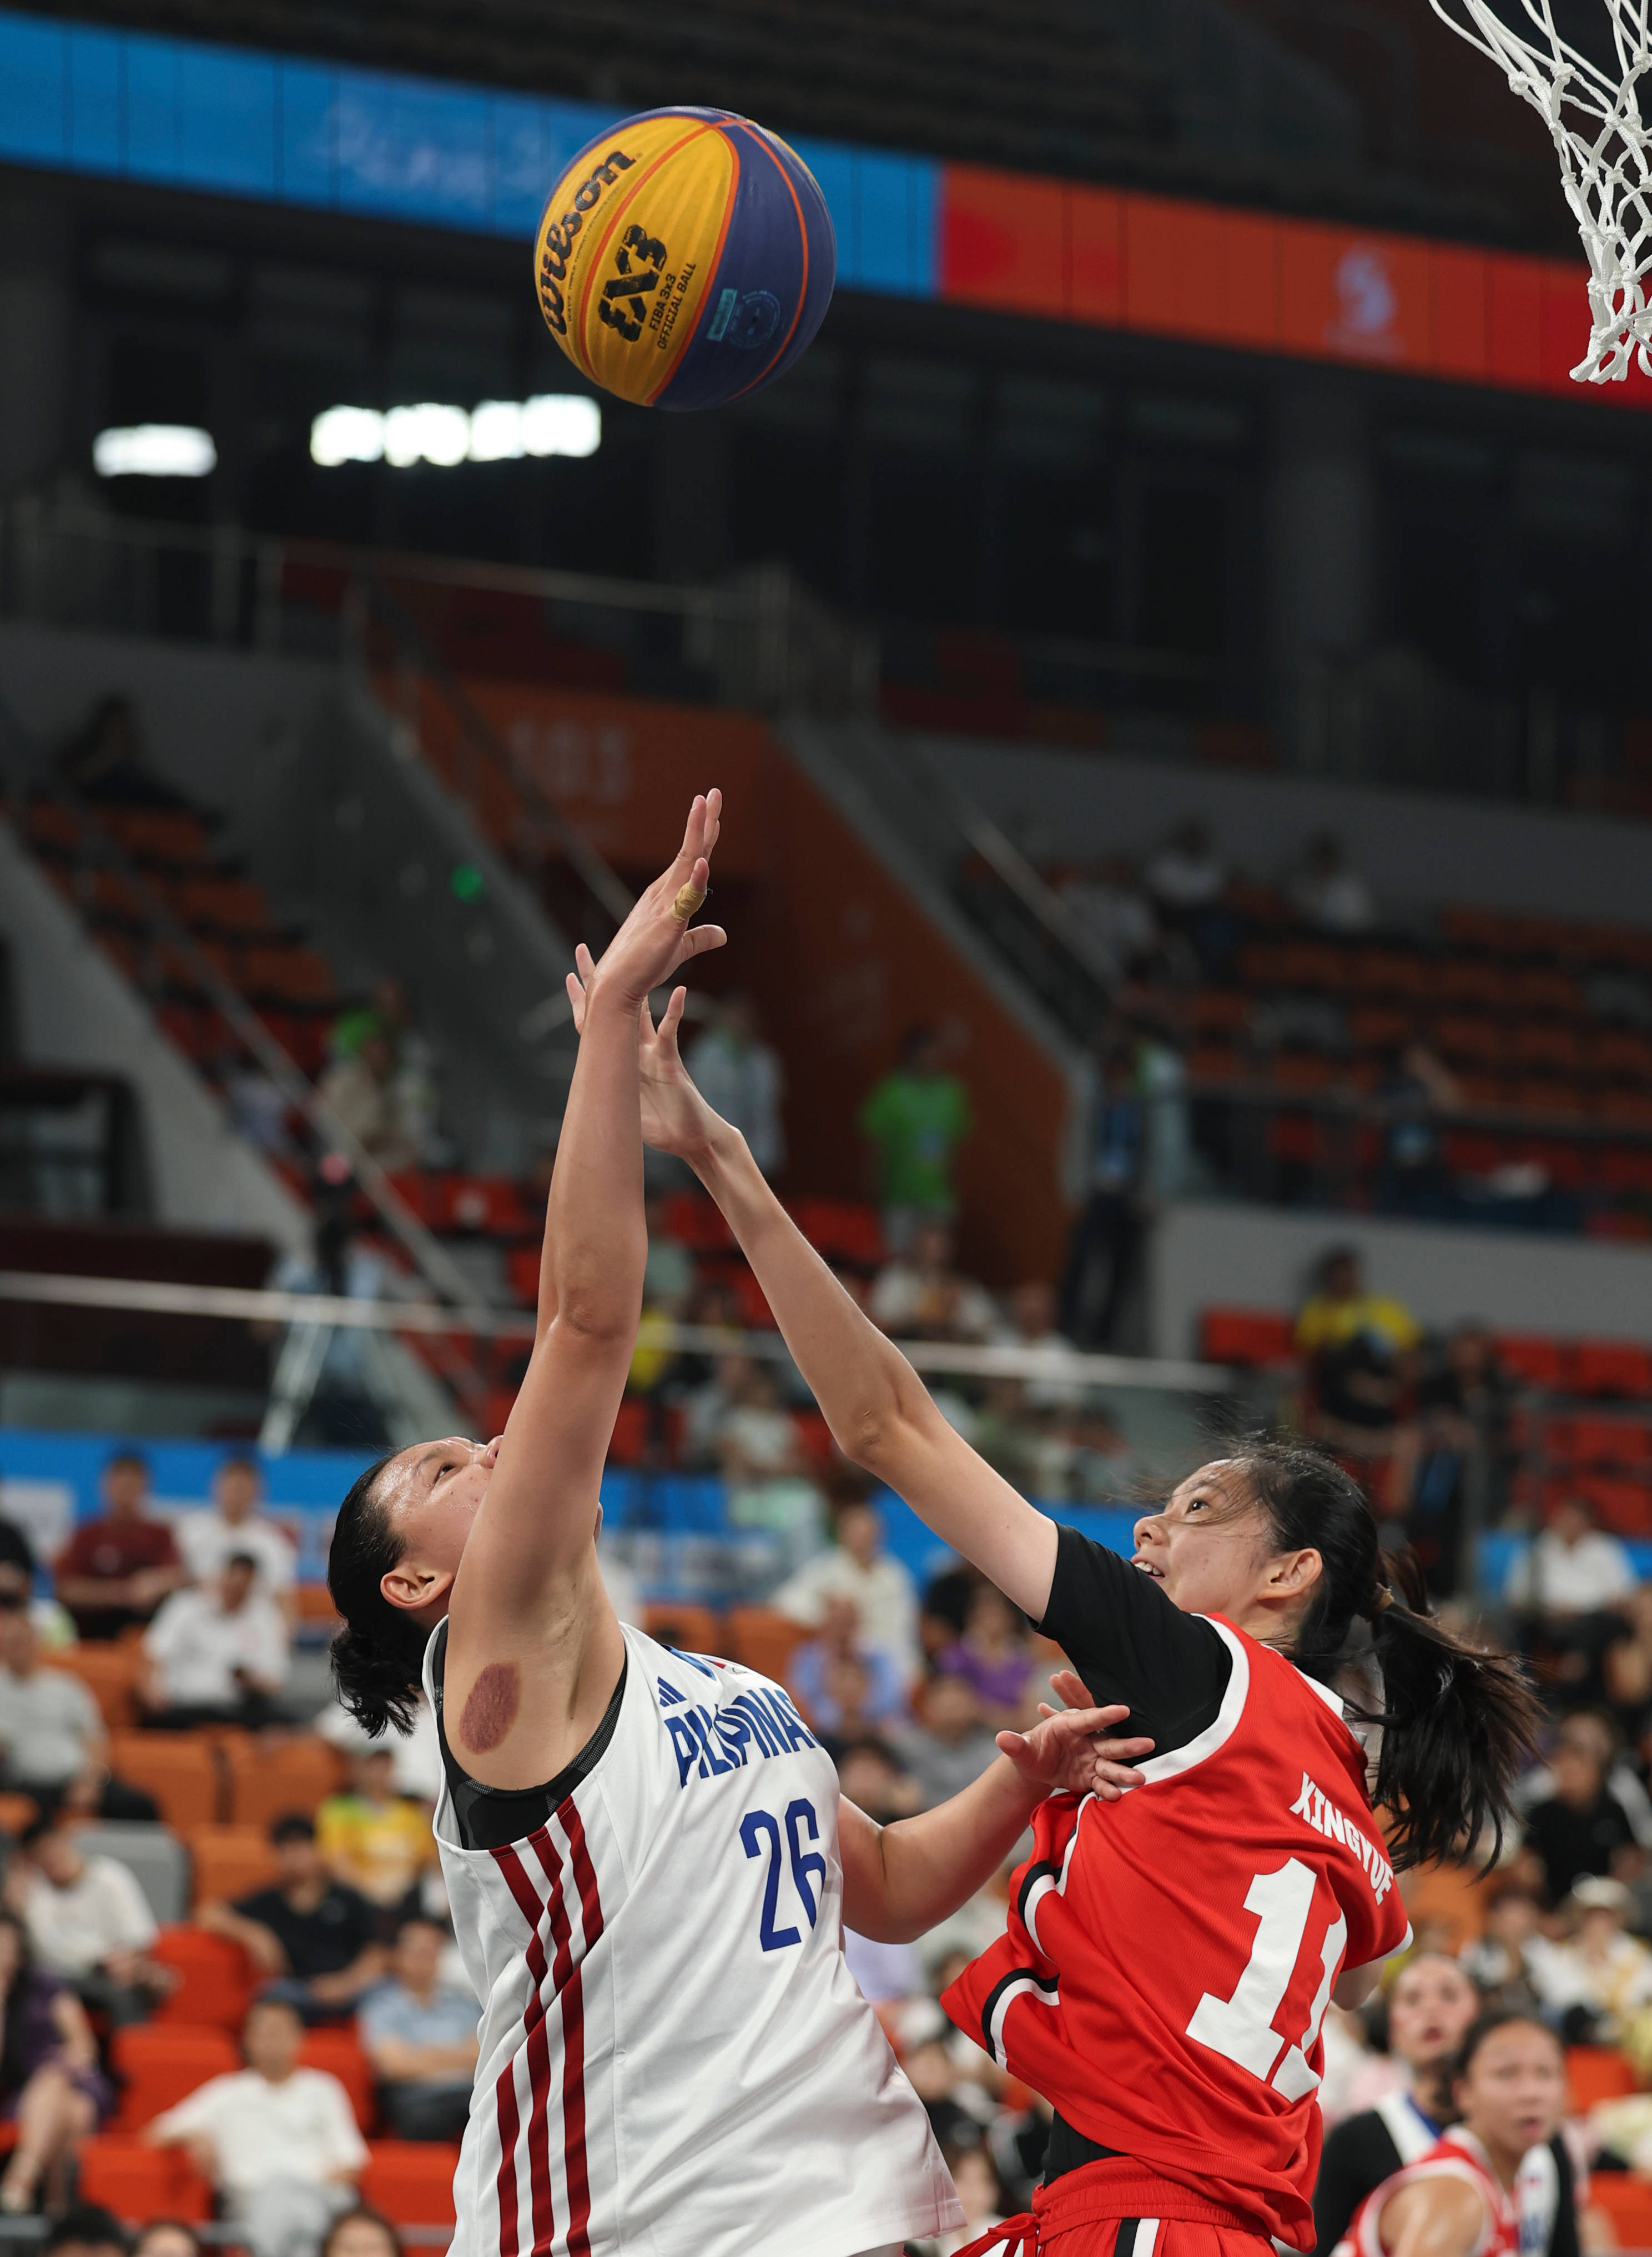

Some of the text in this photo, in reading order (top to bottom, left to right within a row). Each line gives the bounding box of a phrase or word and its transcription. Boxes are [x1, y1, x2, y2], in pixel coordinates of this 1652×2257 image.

[541, 150, 636, 335] Wilson
[649, 273, 676, 331] FIBA 3x3
[657, 263, 696, 350] OFFICIAL BALL
[739, 1798, 827, 1952] 26
[1290, 1771, 1394, 1906] XINGYUE
